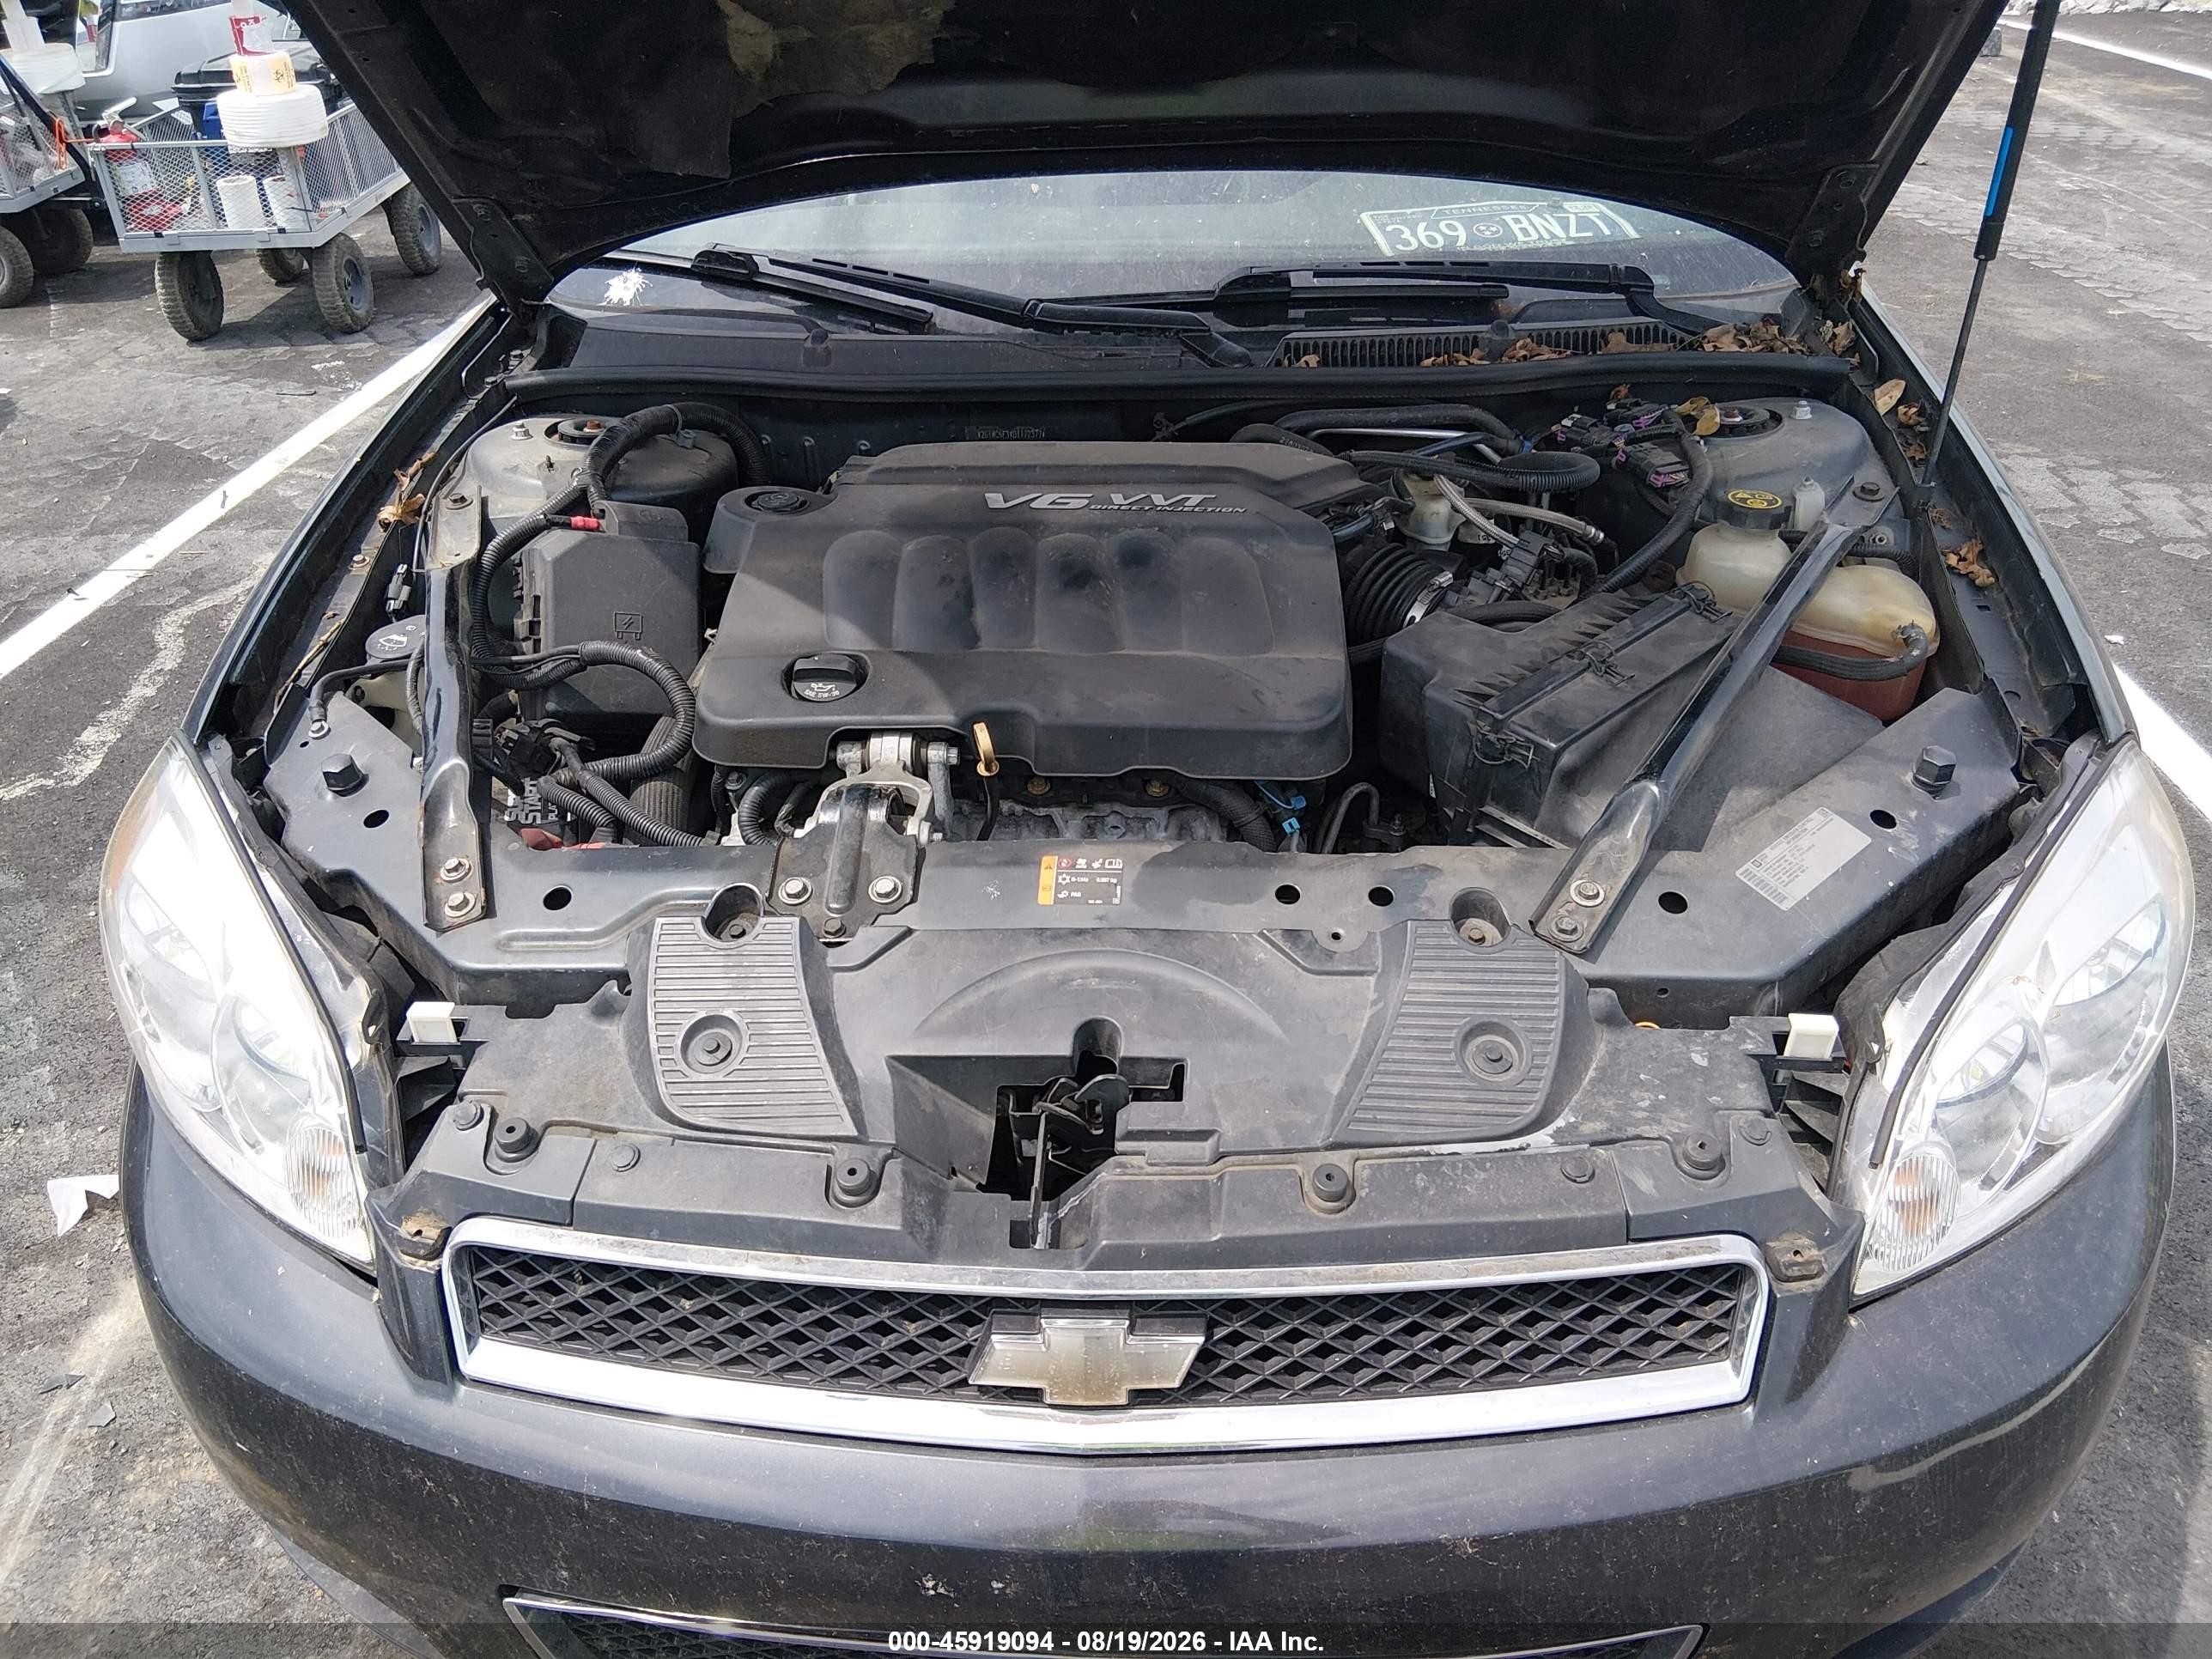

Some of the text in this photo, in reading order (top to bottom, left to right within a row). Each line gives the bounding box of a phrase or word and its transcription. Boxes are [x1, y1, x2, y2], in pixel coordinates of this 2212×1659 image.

[1443, 205, 1530, 216] TENNESSEE
[1386, 220, 1466, 252] 369
[984, 493, 1217, 509] V6 VVT
[520, 777, 542, 824] START
